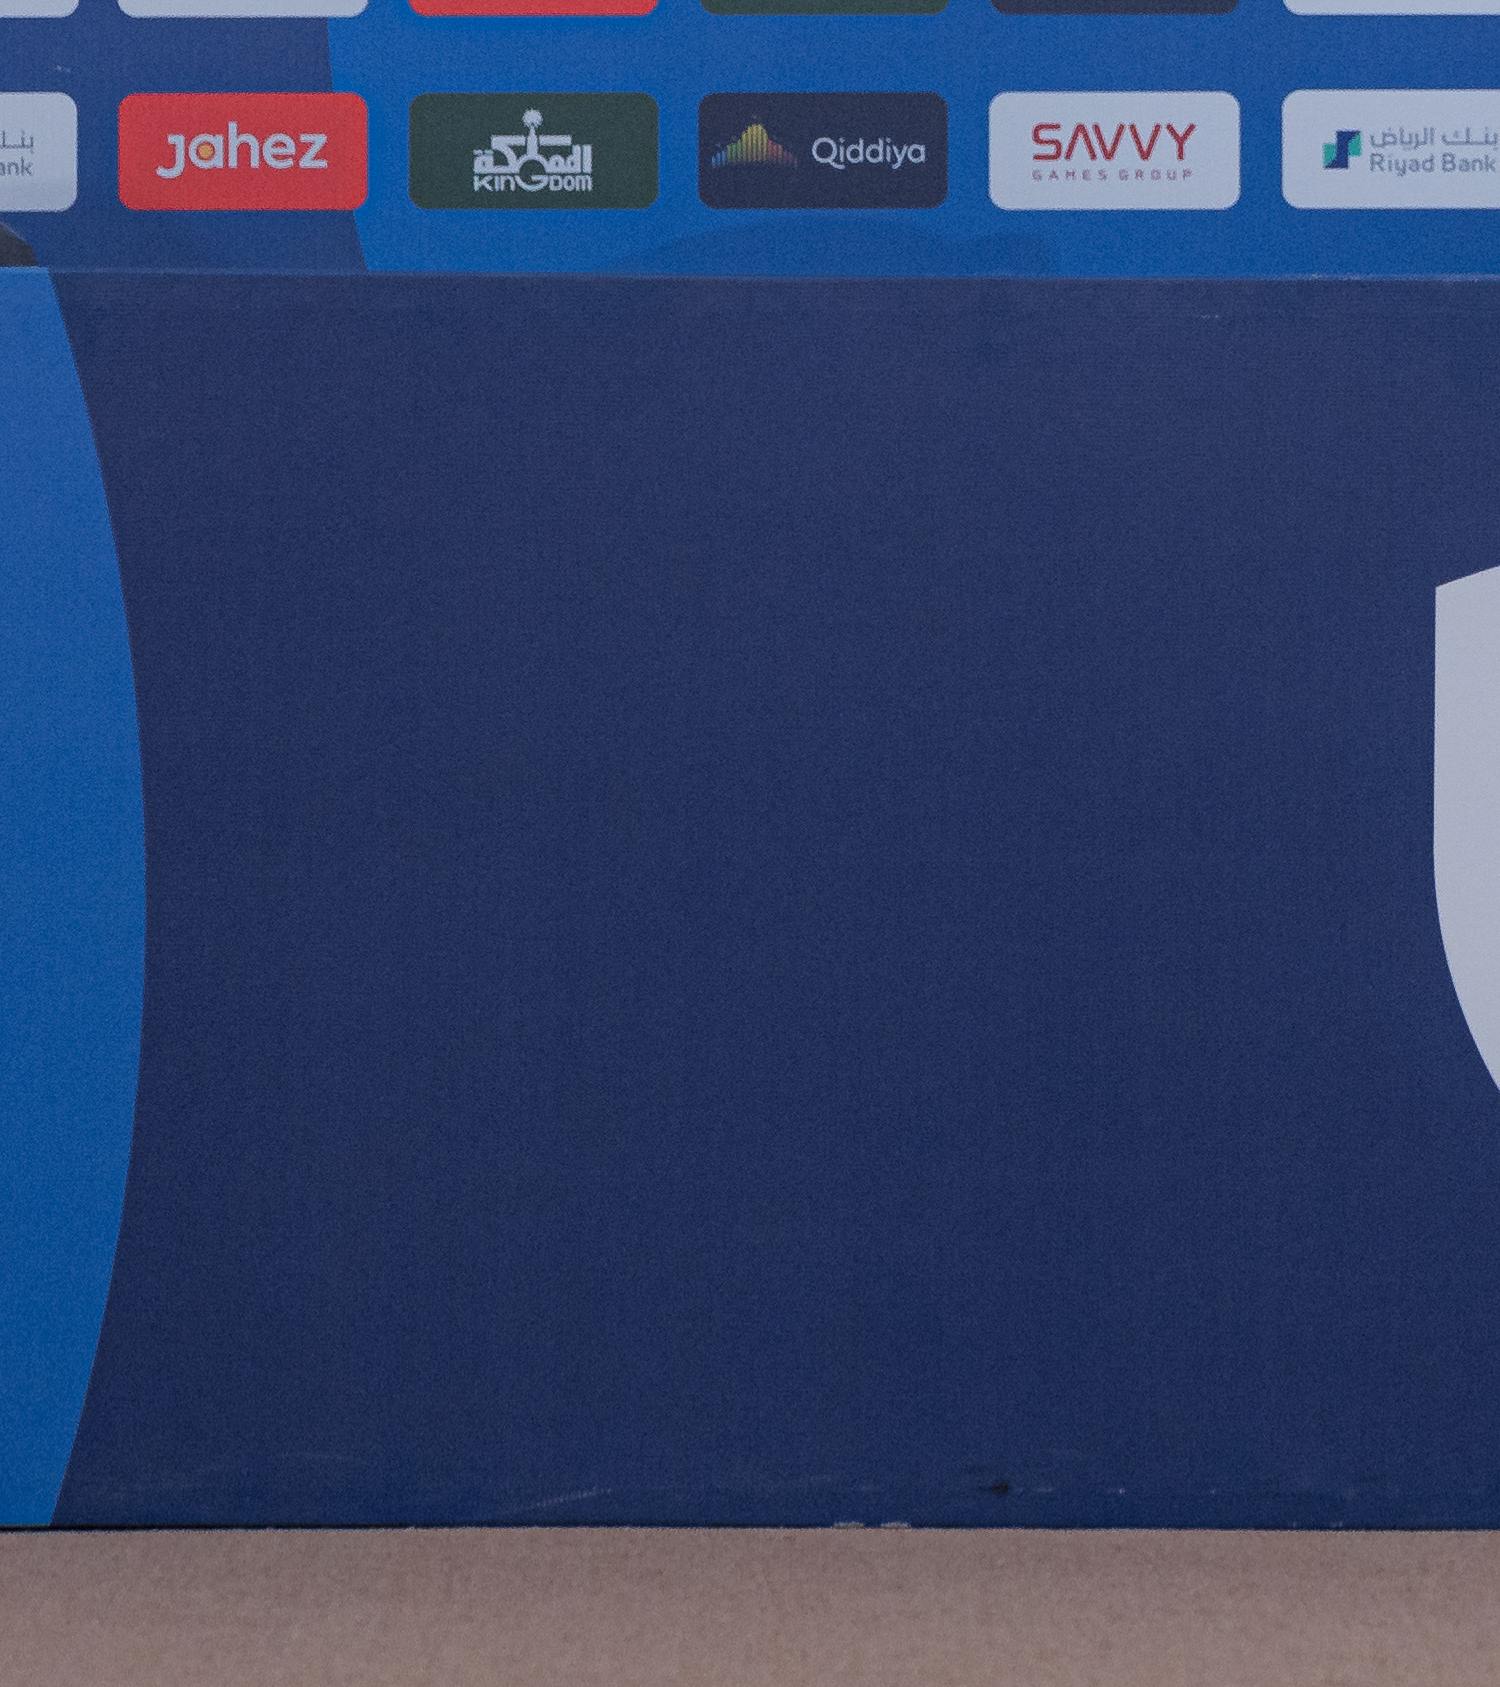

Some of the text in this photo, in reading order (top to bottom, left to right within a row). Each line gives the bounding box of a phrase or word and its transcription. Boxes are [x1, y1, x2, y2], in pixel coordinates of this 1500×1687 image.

[811, 135, 926, 170] Qiddiya
[1032, 123, 1195, 162] SAVVY
[1370, 155, 1496, 178] Riyad Bank
